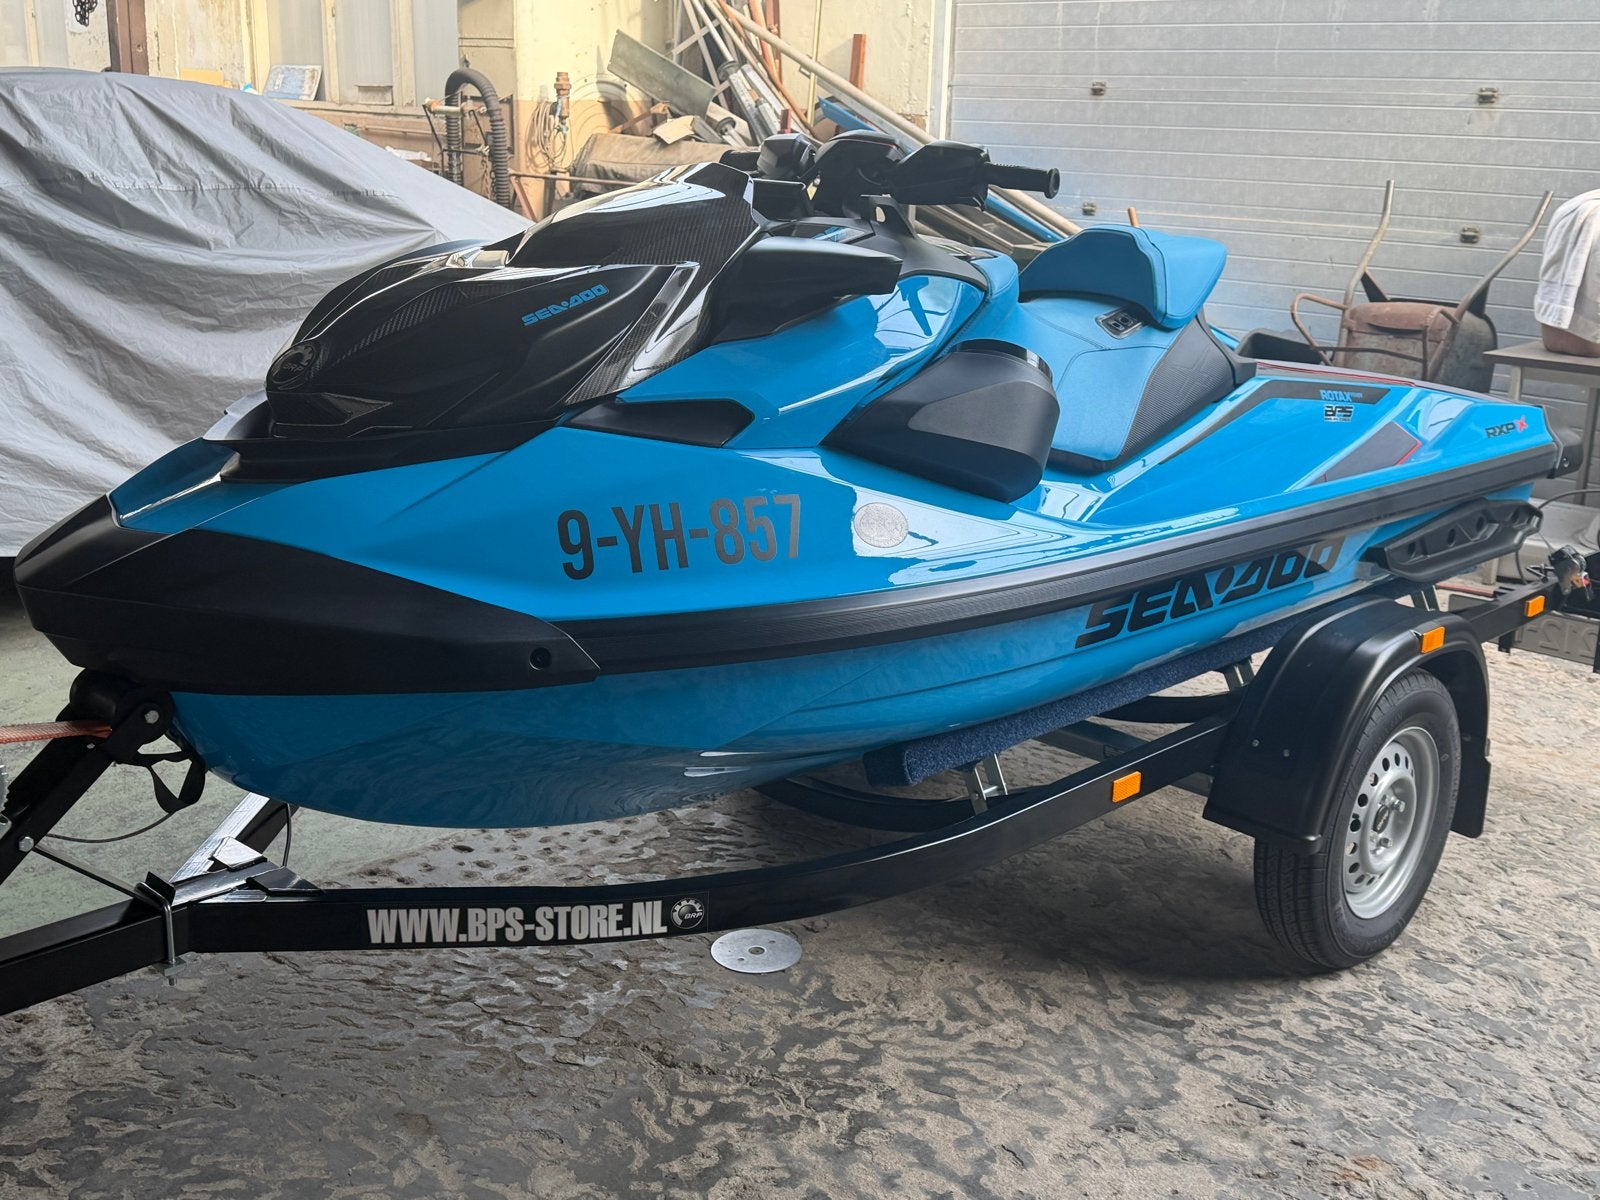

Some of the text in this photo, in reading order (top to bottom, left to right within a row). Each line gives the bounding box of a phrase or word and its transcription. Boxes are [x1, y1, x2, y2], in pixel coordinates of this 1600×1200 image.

[1319, 389, 1353, 402] ROTAX
[557, 494, 801, 581] 9-YH-857
[366, 900, 668, 944] WWW.BPS-STORE.NL
[684, 910, 703, 921] BRP
